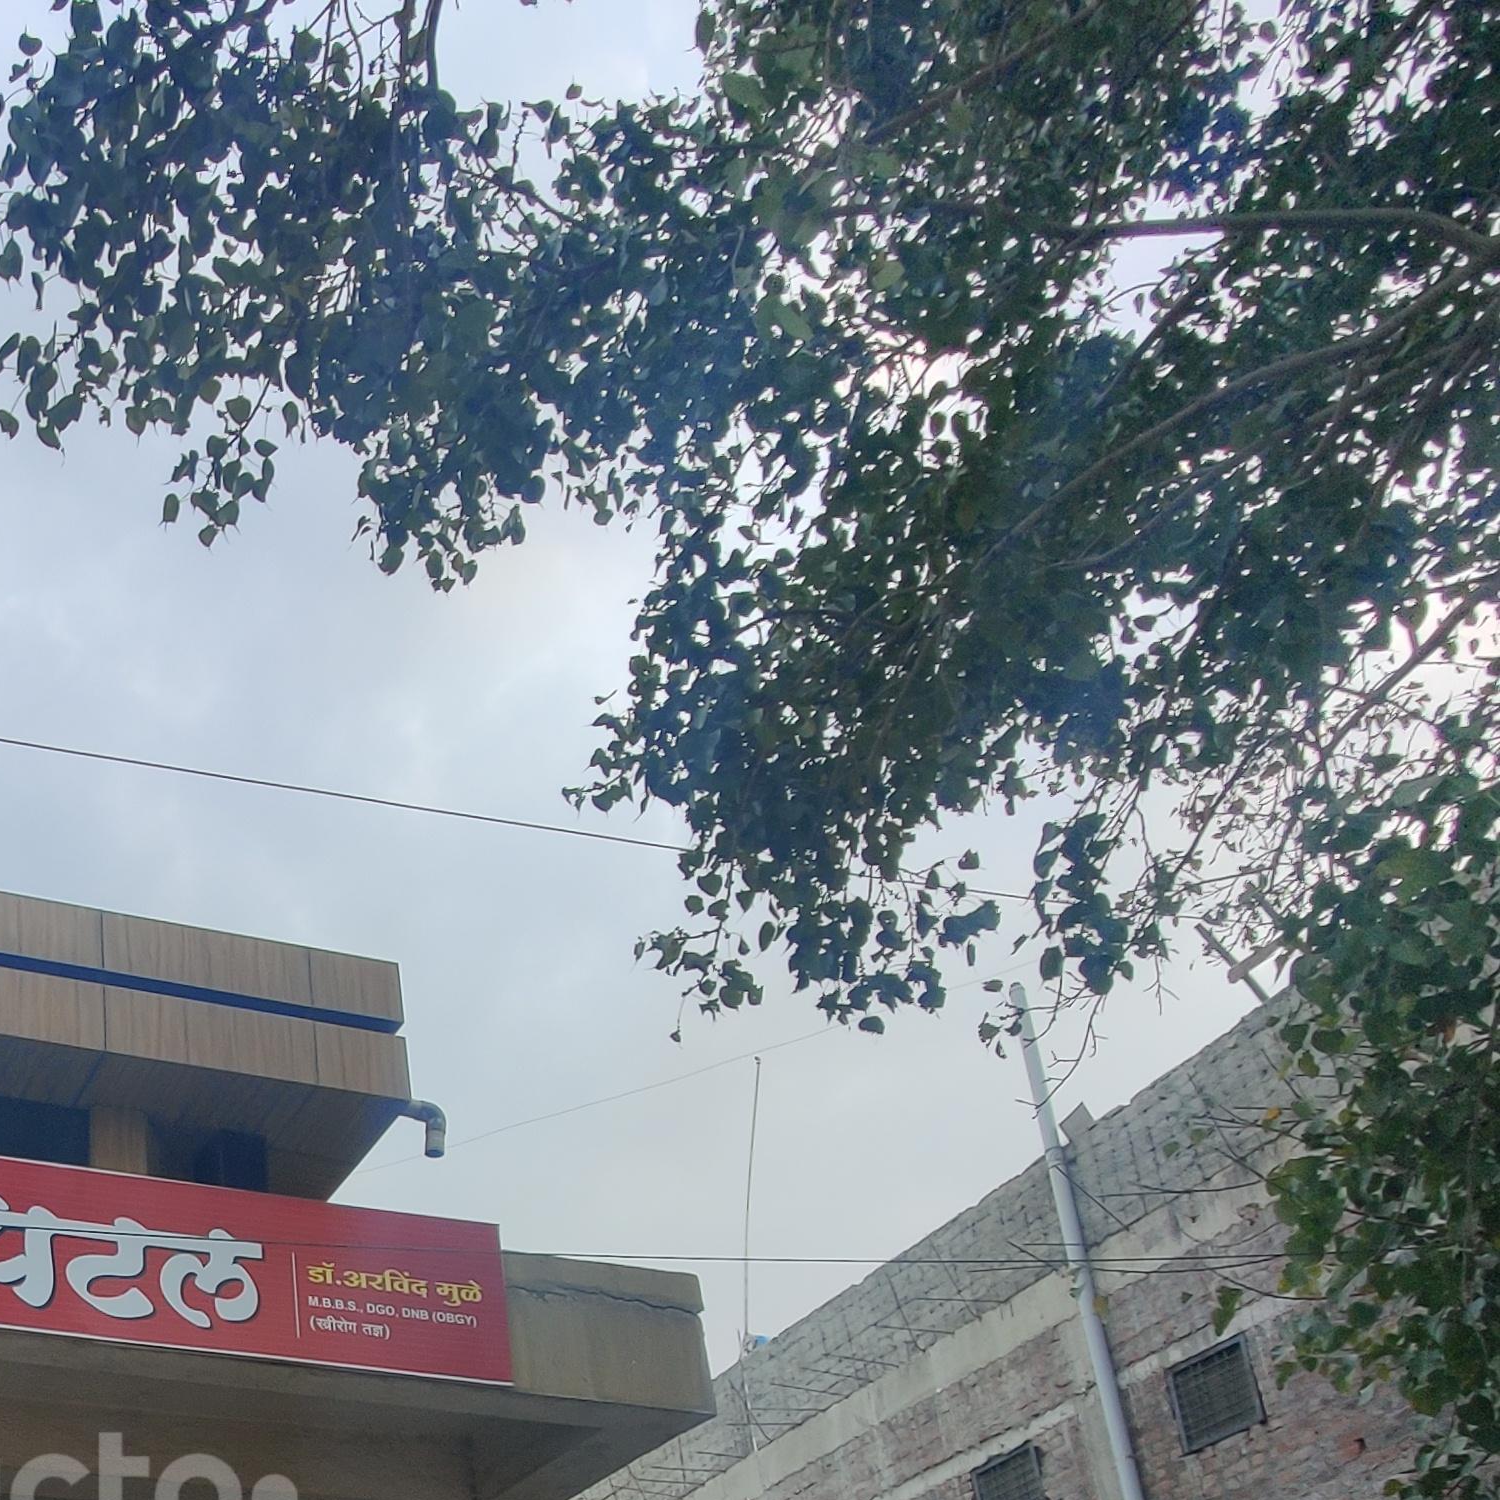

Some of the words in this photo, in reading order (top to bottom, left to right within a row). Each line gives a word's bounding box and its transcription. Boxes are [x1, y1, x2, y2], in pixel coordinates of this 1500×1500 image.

[434, 1279, 483, 1307] मुळे
[401, 1306, 430, 1321] DNB
[432, 1310, 478, 1328] (OBGY)
